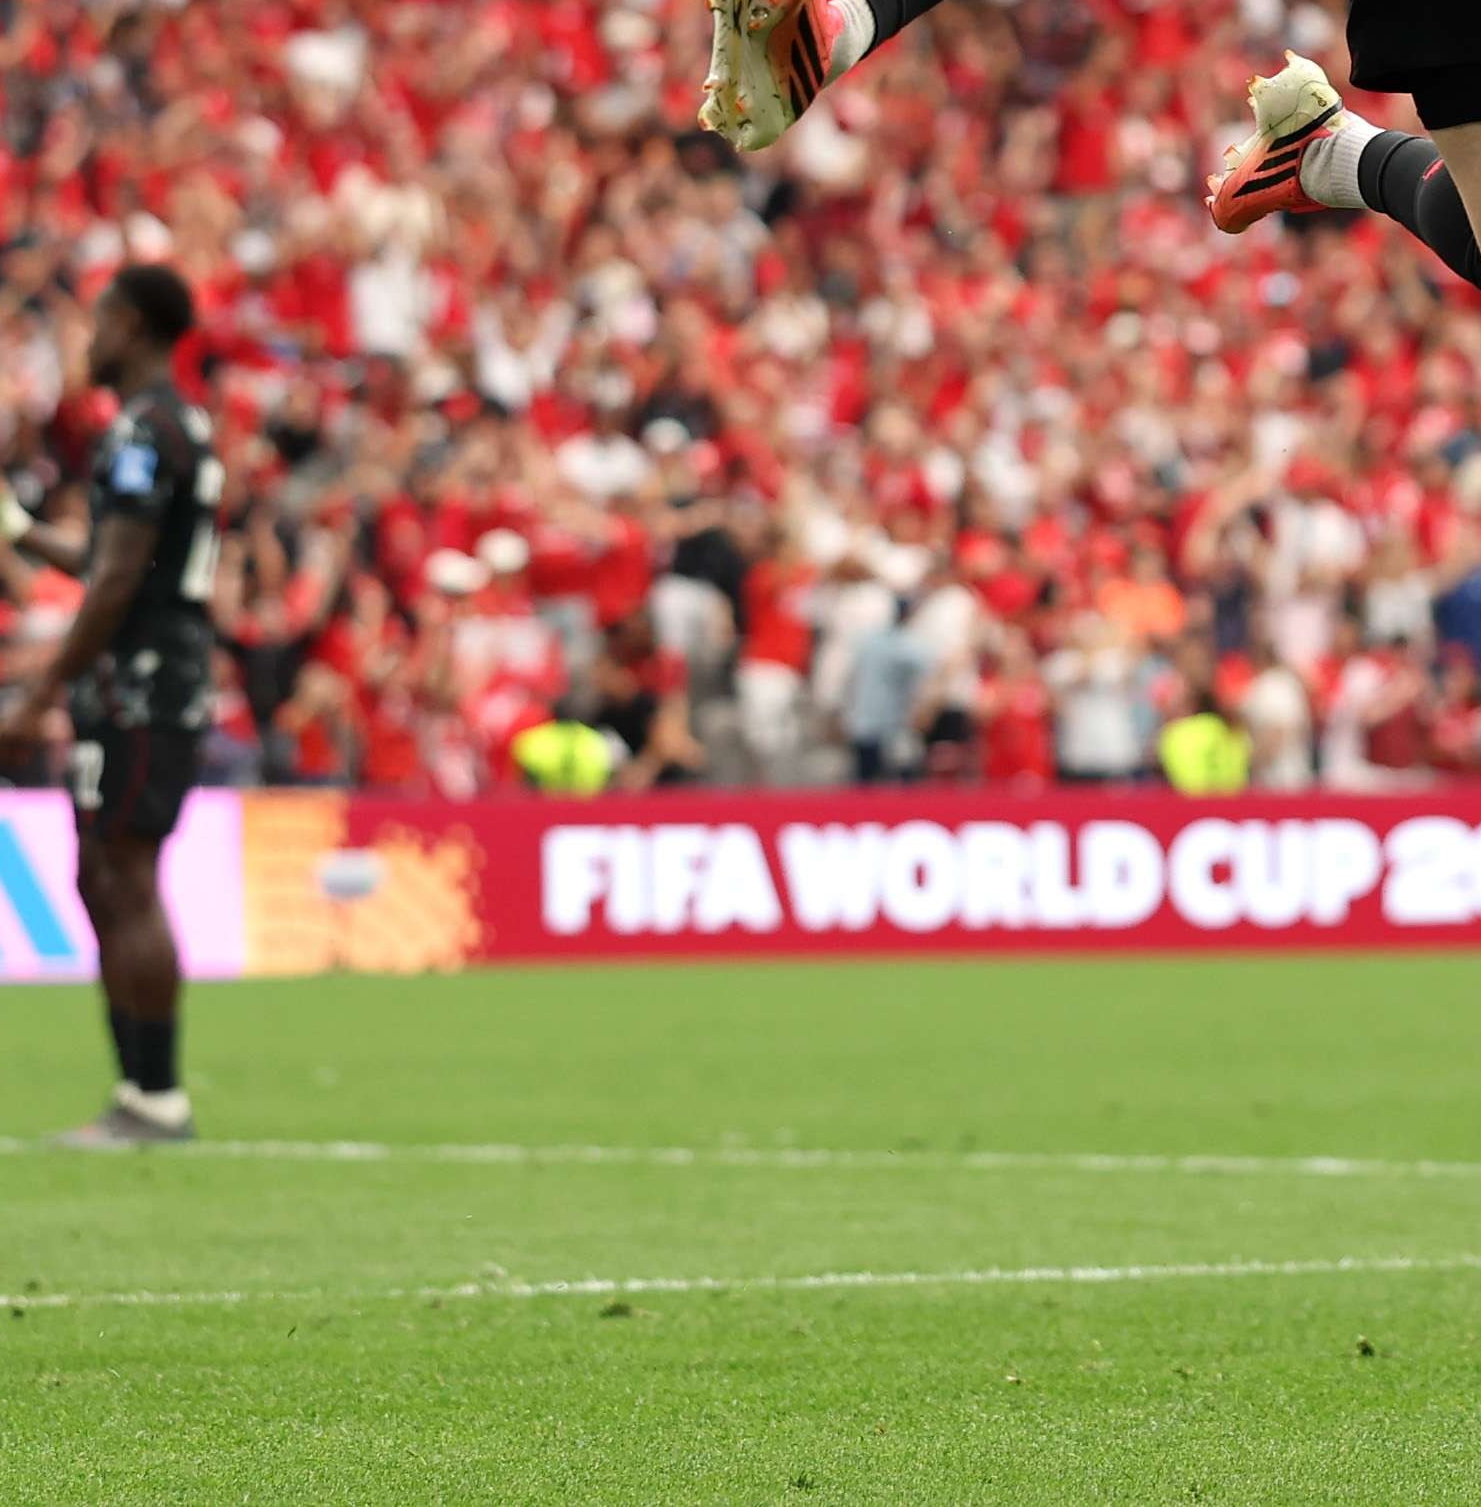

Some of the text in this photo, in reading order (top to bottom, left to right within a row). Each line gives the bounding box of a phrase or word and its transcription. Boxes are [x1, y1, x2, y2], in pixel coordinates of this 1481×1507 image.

[540, 824, 783, 935] FIFA
[776, 819, 1168, 932] WORLD
[1168, 817, 1383, 930] CUP
